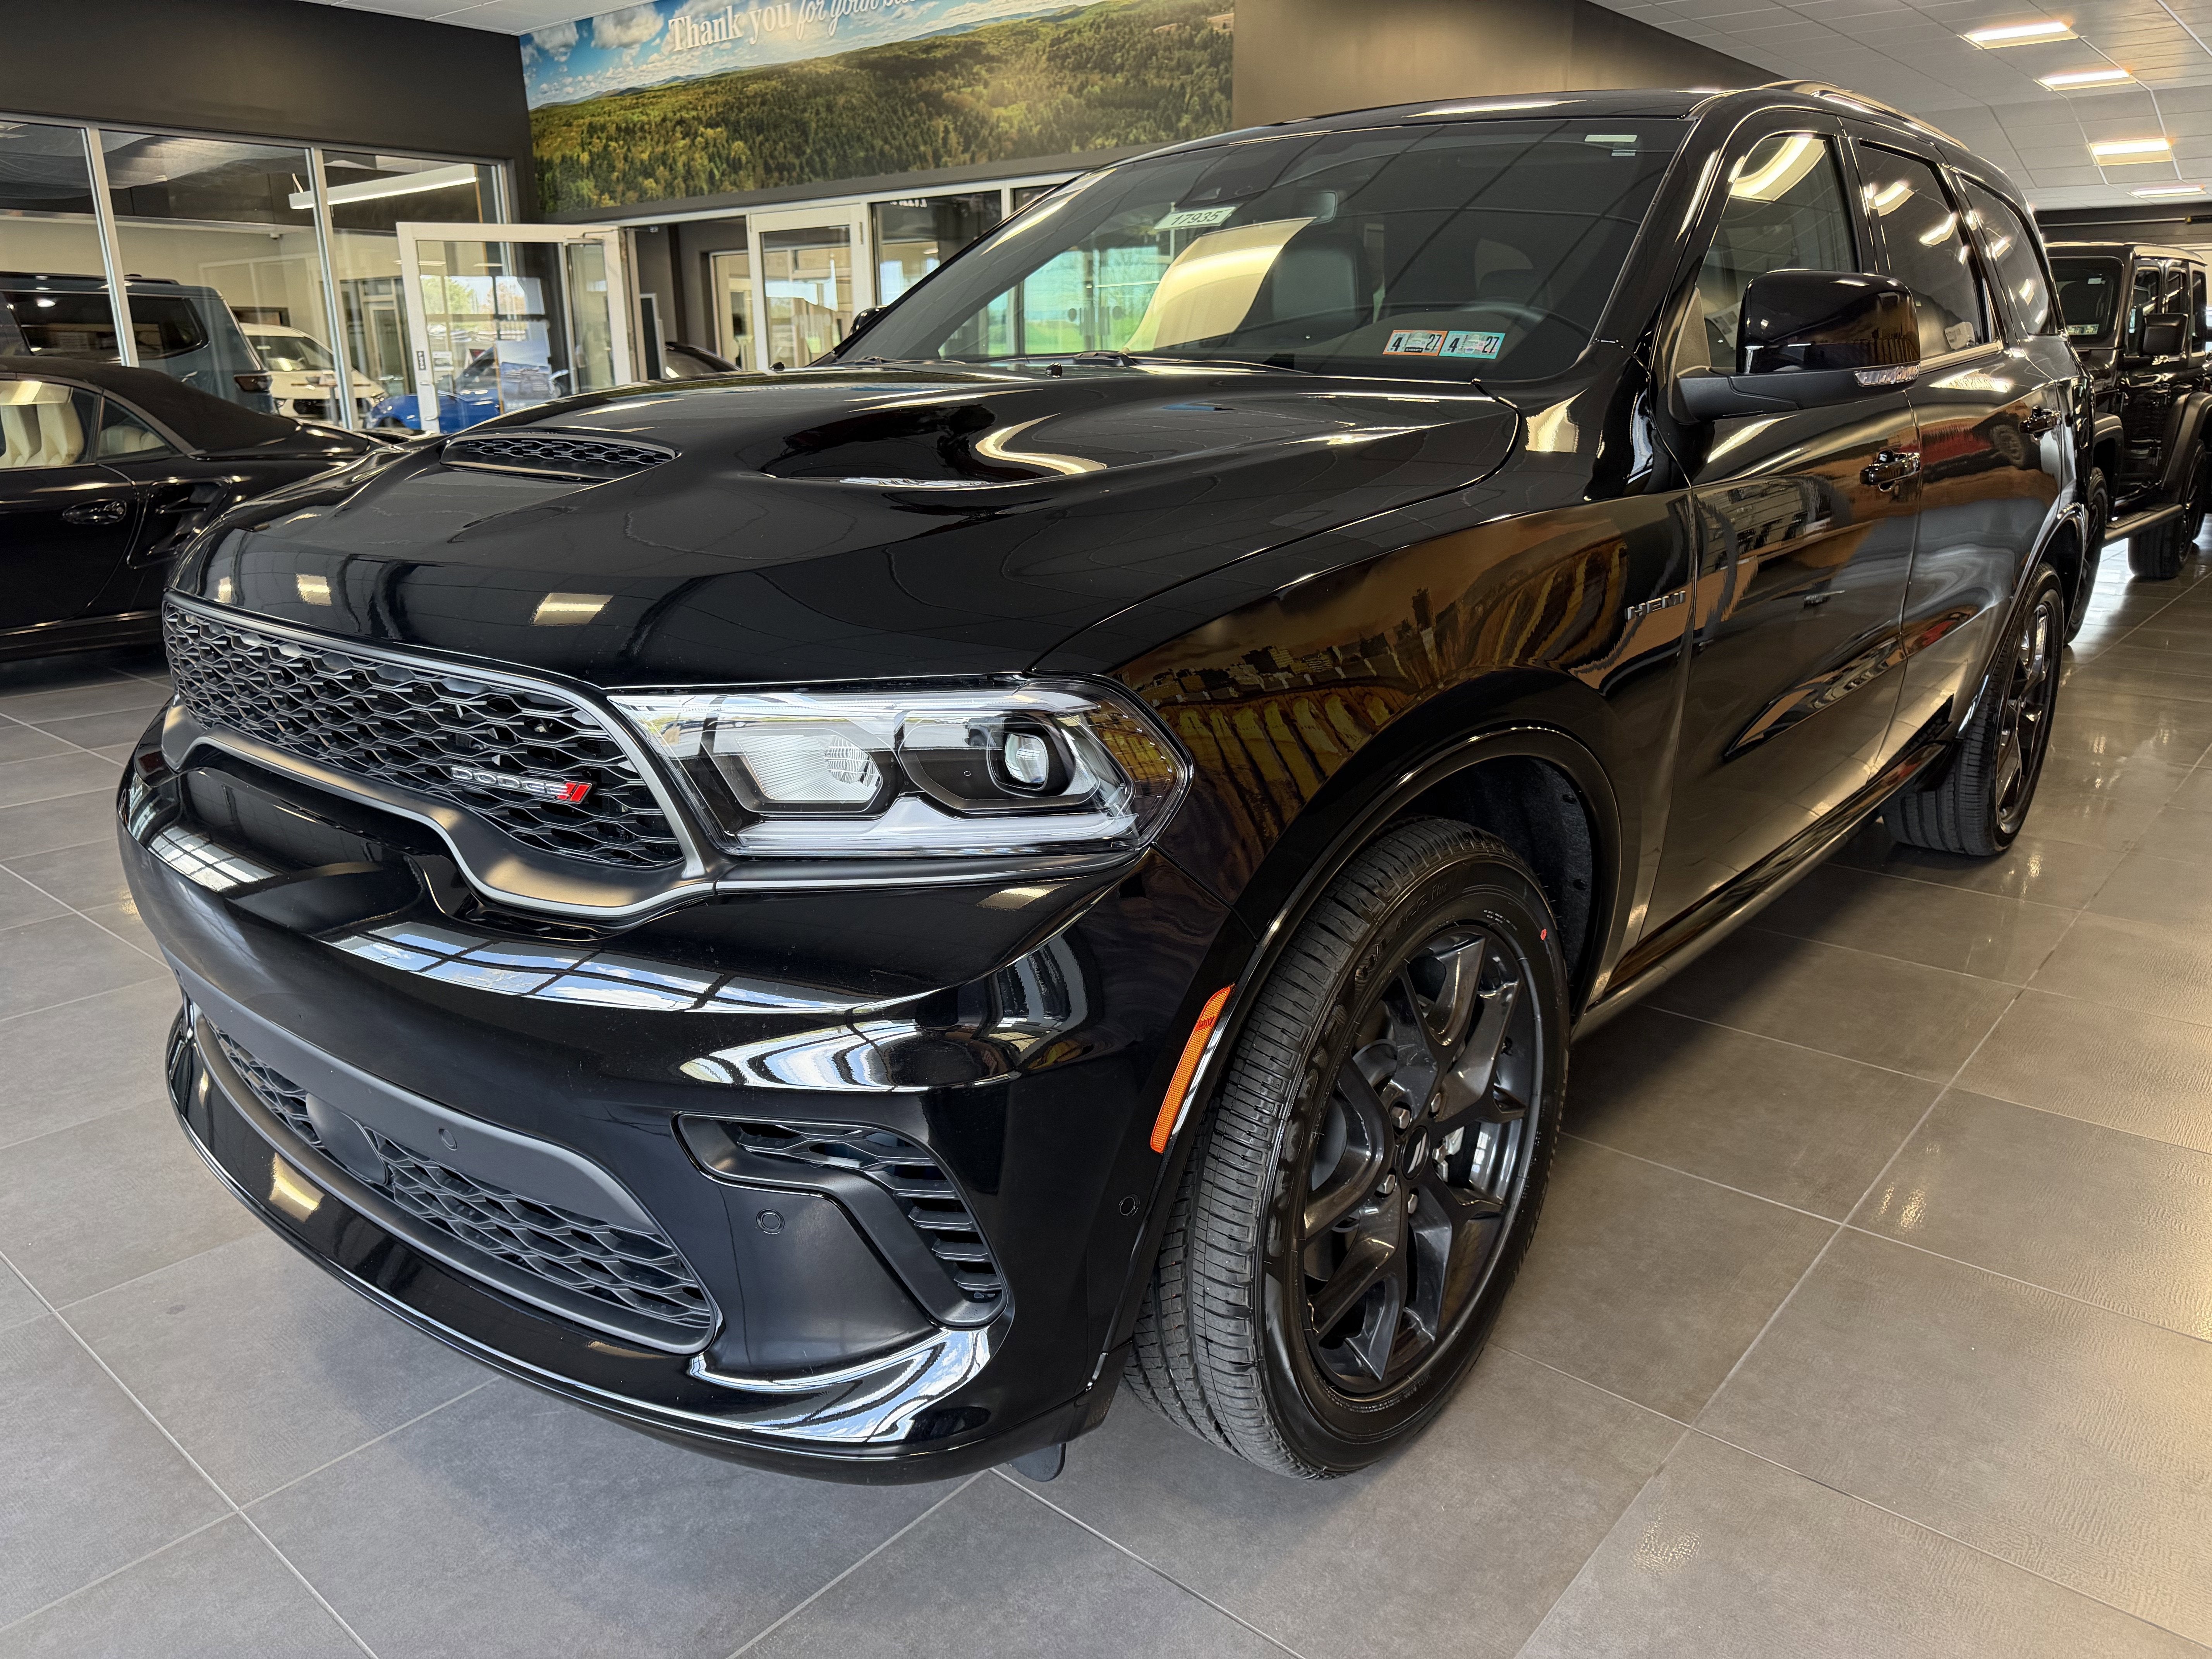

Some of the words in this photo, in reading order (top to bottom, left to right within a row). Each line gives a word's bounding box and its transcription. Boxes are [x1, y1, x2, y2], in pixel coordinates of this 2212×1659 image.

[668, 5, 744, 51] Thank
[748, 3, 793, 45] you
[796, 0, 827, 40] for
[1171, 210, 1224, 226] 17935
[1392, 337, 1403, 352] 4
[1424, 334, 1442, 351] 27
[1449, 338, 1460, 353] 4
[1482, 336, 1500, 353] 27
[1626, 590, 1686, 620] HEMI
[451, 767, 570, 797] DODGE
